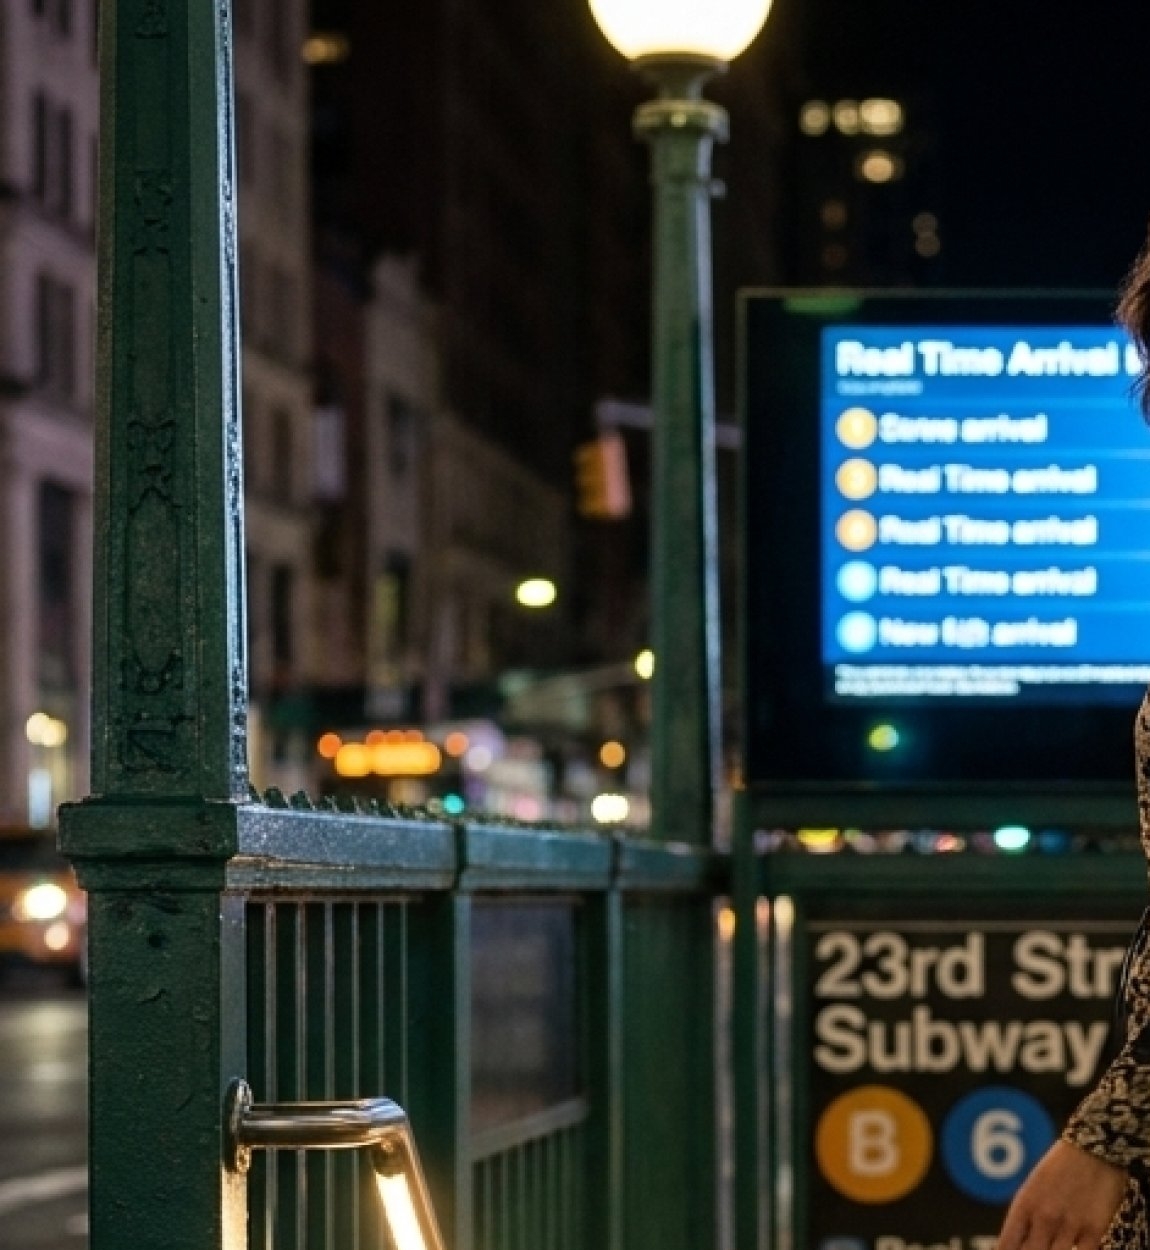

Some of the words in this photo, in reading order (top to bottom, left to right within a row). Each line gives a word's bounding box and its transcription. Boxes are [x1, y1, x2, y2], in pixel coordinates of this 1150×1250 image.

[837, 341, 914, 376] Real
[918, 341, 1004, 376] Time
[1007, 341, 1119, 376] Arrival
[815, 931, 985, 998] 23rd
[1012, 931, 1124, 998] Str
[815, 1005, 1108, 1085] Subway
[849, 1110, 898, 1176] B
[971, 1109, 1025, 1179] 6
